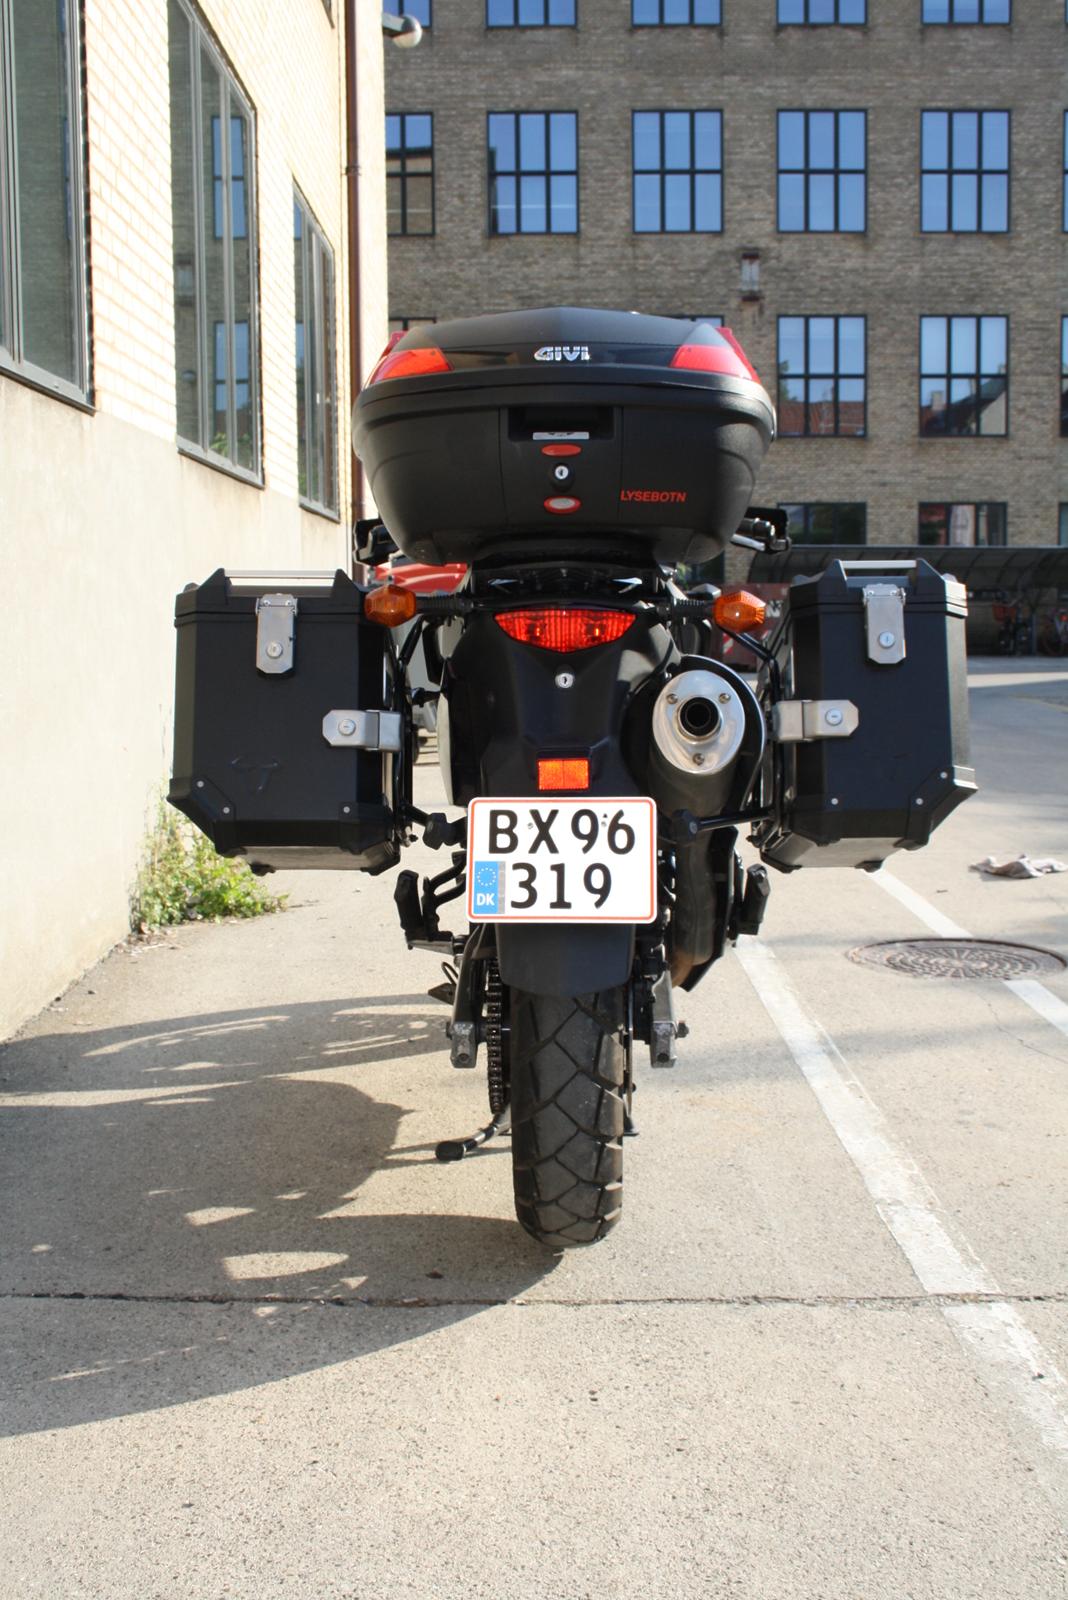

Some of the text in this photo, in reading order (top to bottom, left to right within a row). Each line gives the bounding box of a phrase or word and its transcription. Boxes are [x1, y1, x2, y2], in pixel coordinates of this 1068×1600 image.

[534, 346, 590, 361] GIVI
[620, 490, 687, 502] LYSEBOTN
[510, 862, 612, 909] 319
[476, 893, 495, 906] DK
